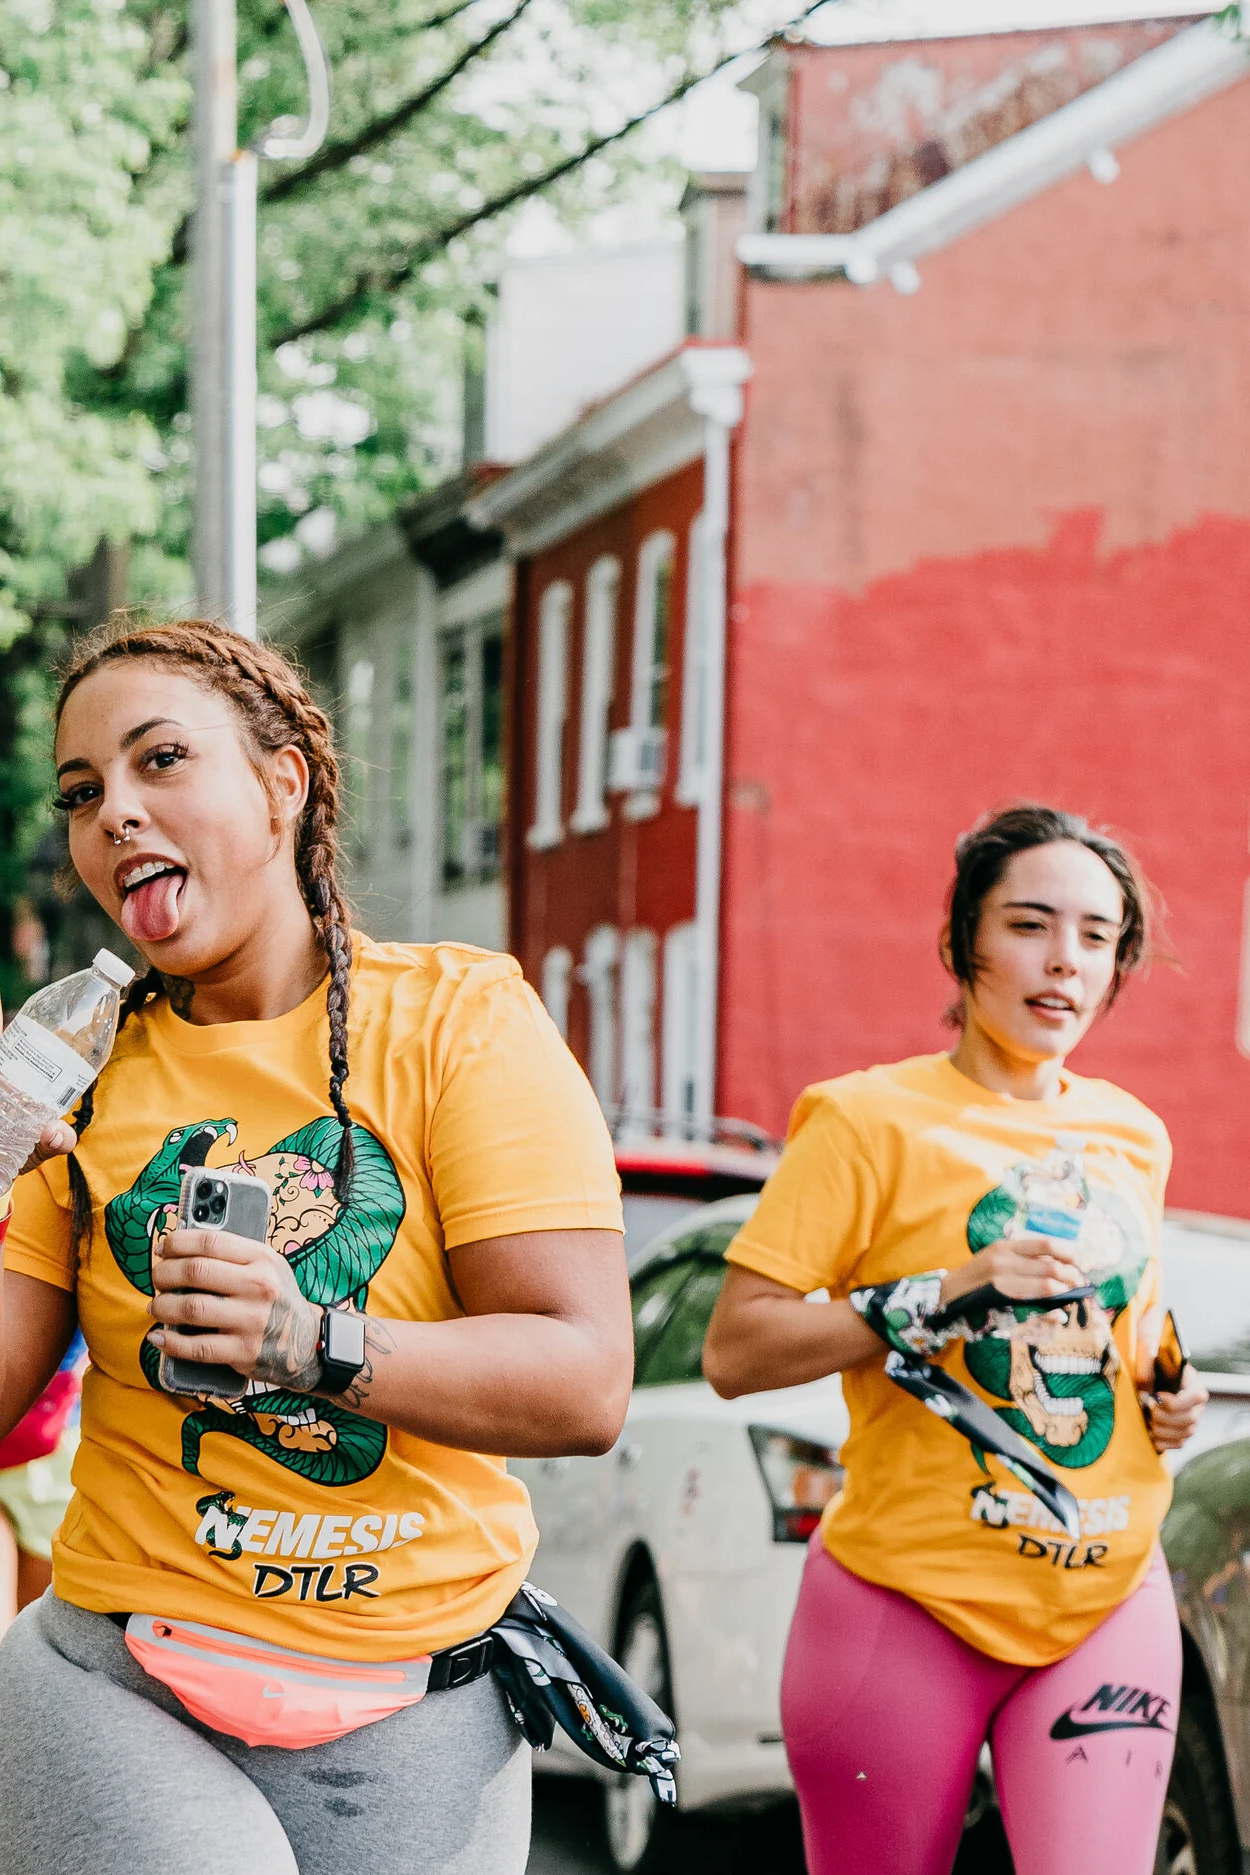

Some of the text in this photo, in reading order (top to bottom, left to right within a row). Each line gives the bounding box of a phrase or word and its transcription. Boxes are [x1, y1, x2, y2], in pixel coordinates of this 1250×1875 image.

[194, 1504, 425, 1558] NEMESIS
[1018, 1534, 1108, 1569] DTLR
[253, 1562, 382, 1602] DTLR
[1081, 1684, 1171, 1721] NIKE
